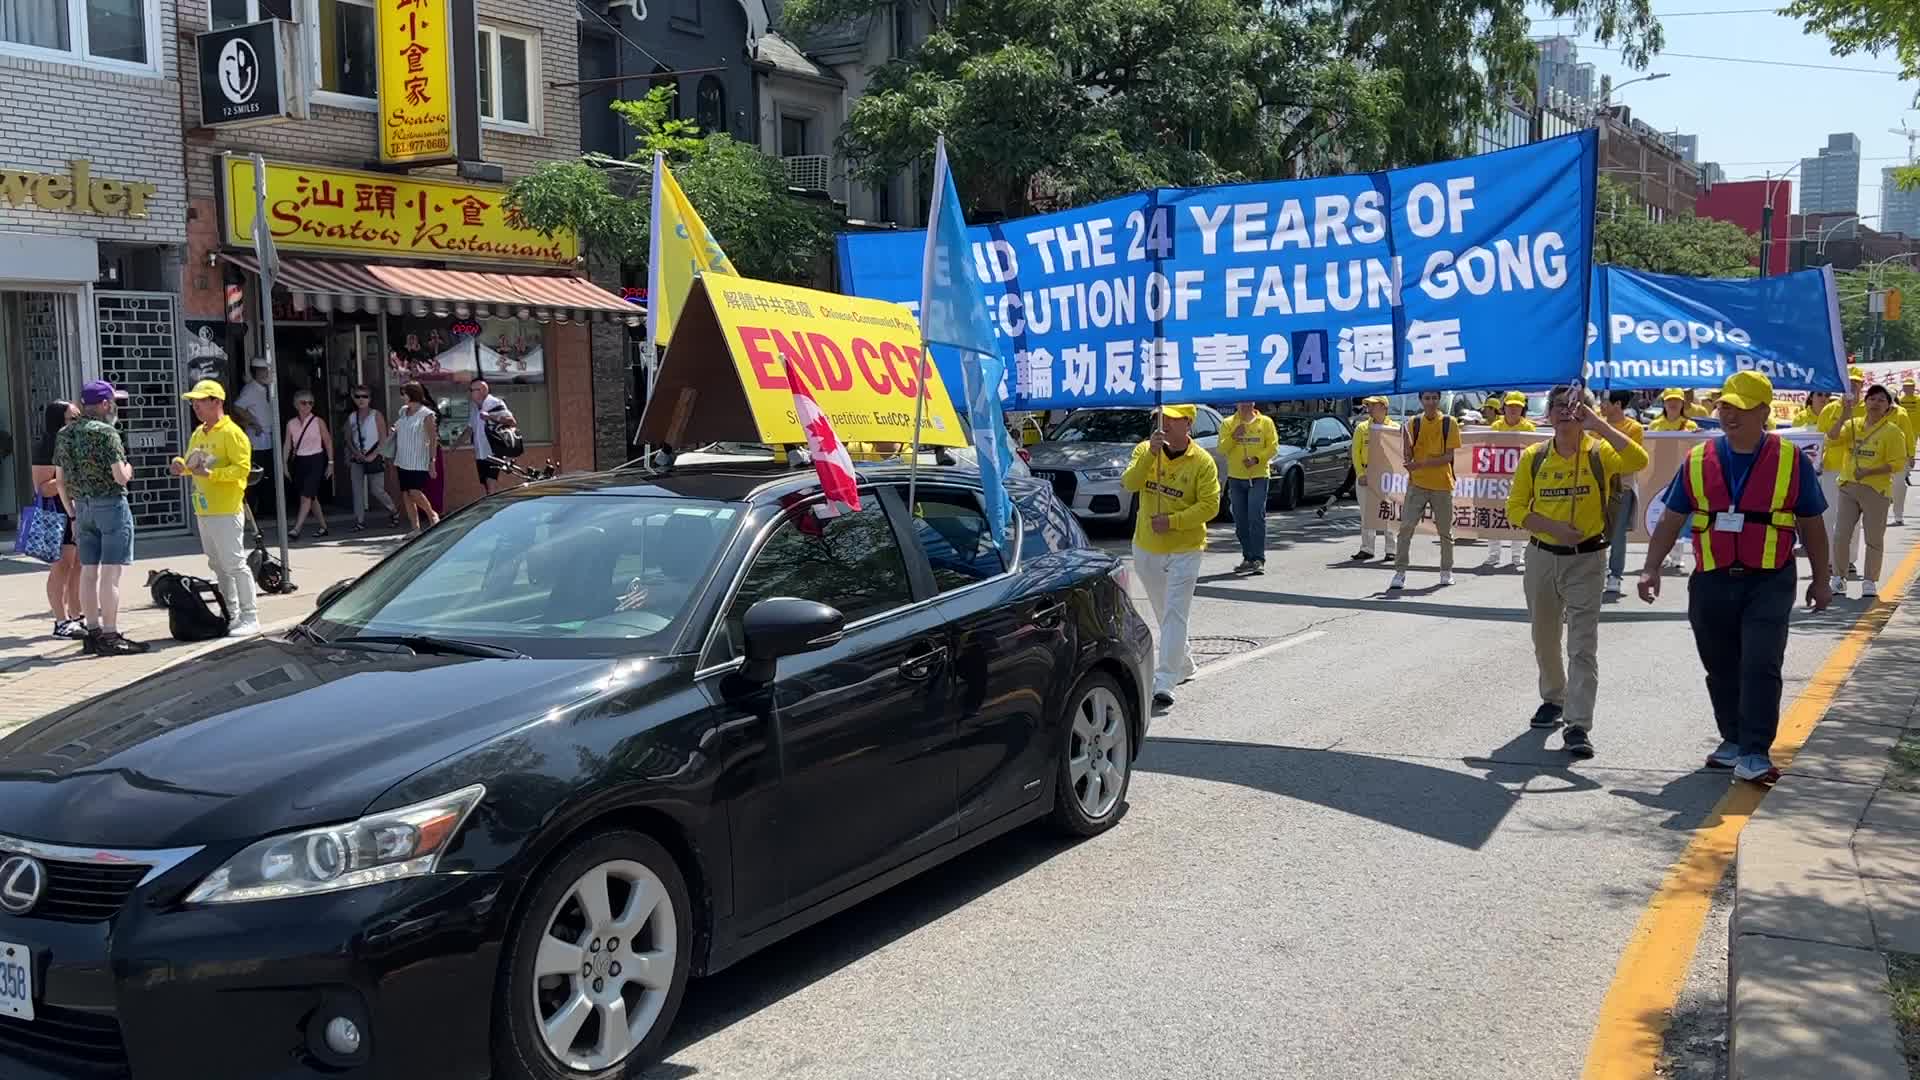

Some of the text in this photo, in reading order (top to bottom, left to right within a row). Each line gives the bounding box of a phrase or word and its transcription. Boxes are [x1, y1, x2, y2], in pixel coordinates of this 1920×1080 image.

[233, 103, 260, 115] SMILES
[271, 200, 562, 259] Swatow Restaurant
[1026, 217, 1116, 274] THE
[1126, 207, 1173, 262] 24
[1189, 190, 1387, 255] YEARS
[1406, 176, 1476, 238] OF
[1145, 271, 1205, 322] OF
[1226, 255, 1403, 319] FALUN
[1420, 231, 1568, 300] GONG
[1610, 314, 1753, 349] People
[736, 326, 933, 400] END CCP
[1735, 354, 1816, 385] Party
[832, 411, 872, 427] petition:
[1477, 446, 1519, 473] STO
[0, 961, 26, 1001] 358
